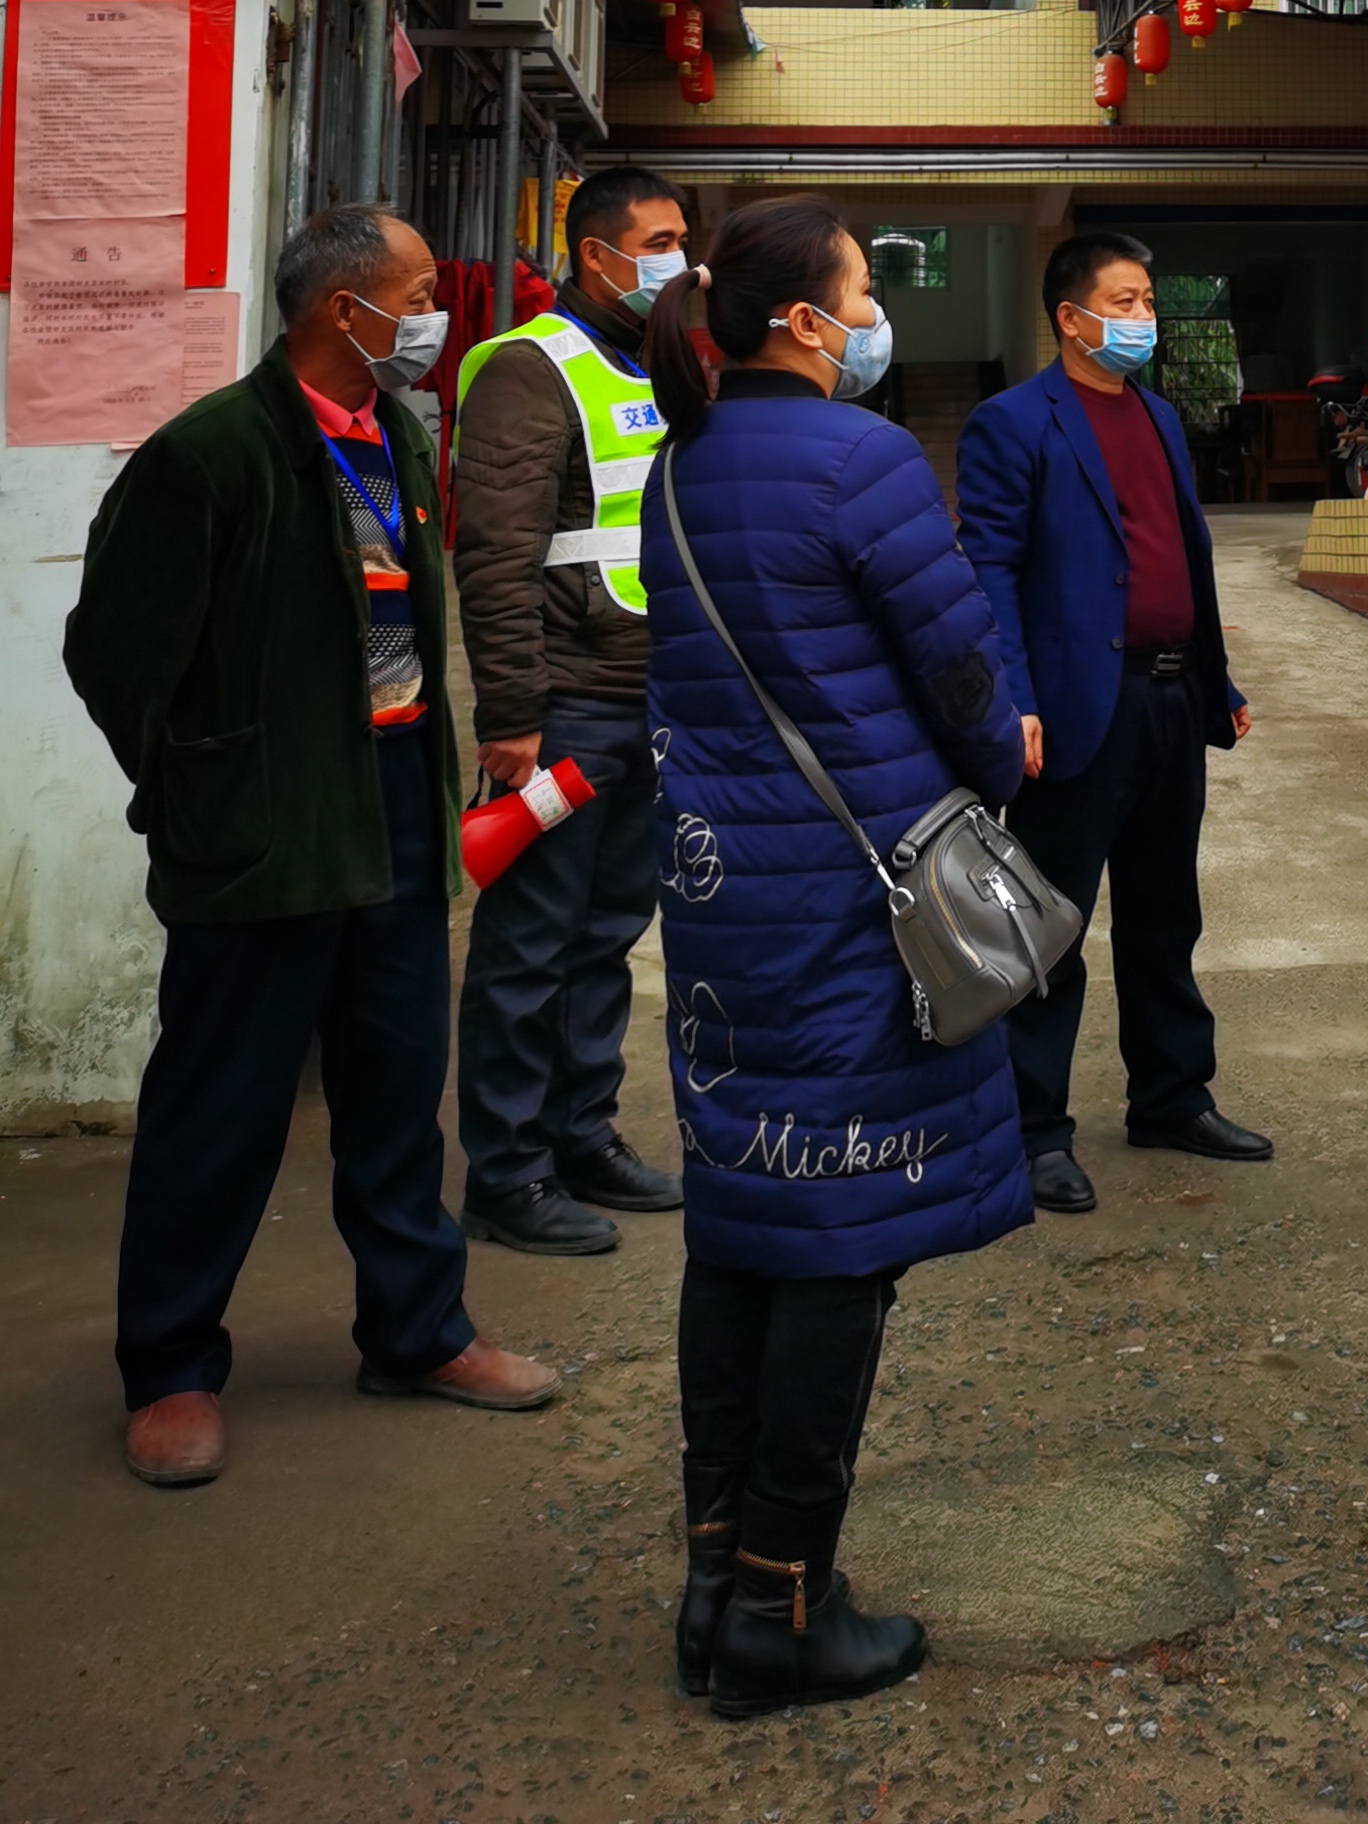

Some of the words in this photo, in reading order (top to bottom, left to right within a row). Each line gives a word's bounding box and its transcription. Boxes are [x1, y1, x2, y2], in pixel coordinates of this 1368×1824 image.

[71, 246, 122, 262] 通告
[621, 404, 667, 430] 交通
[737, 1113, 949, 1183] Mickey
